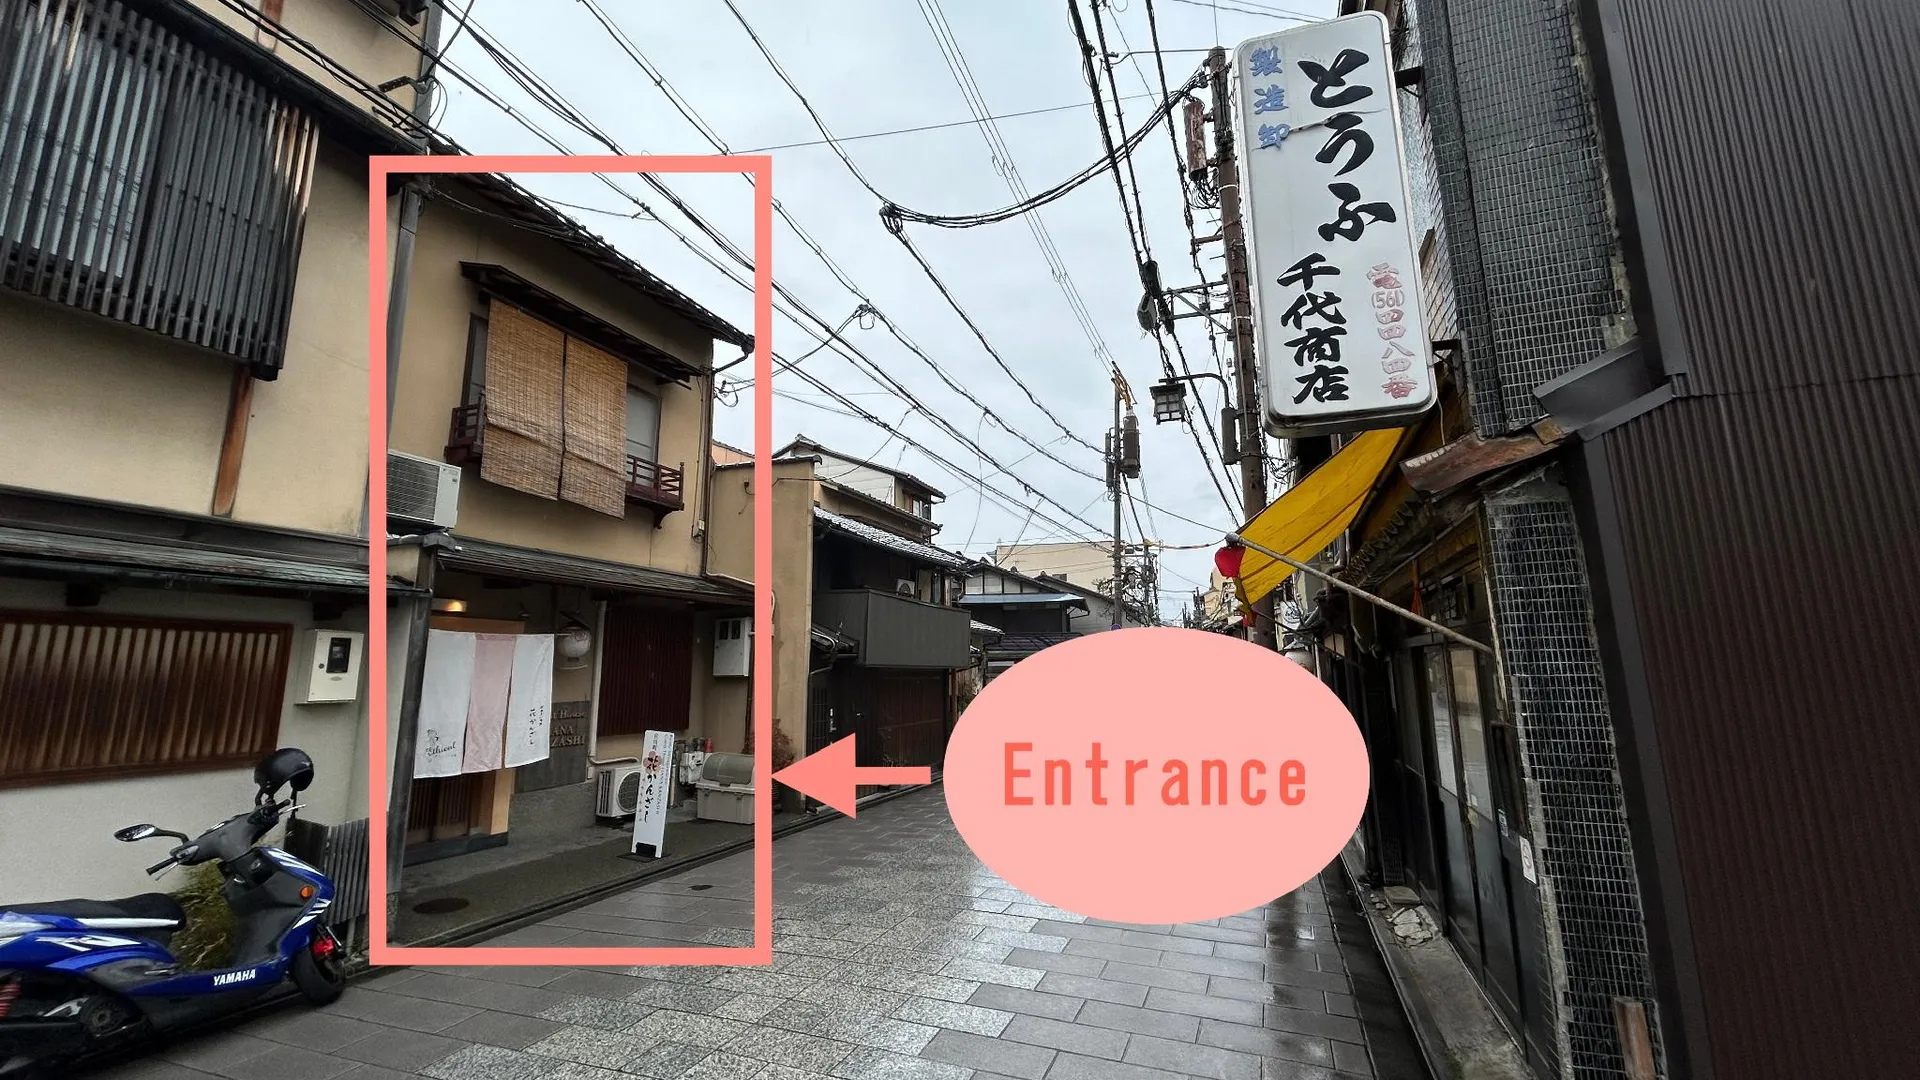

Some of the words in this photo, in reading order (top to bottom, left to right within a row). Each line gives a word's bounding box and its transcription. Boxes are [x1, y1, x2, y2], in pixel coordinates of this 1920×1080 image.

[1250, 46, 1291, 150] 製造卸
[1297, 49, 1397, 242] とうふ
[1277, 252, 1349, 404] 千代商店
[551, 735, 585, 747] ZASHI
[552, 725, 574, 736] ANA
[213, 968, 256, 986] YAMAHA
